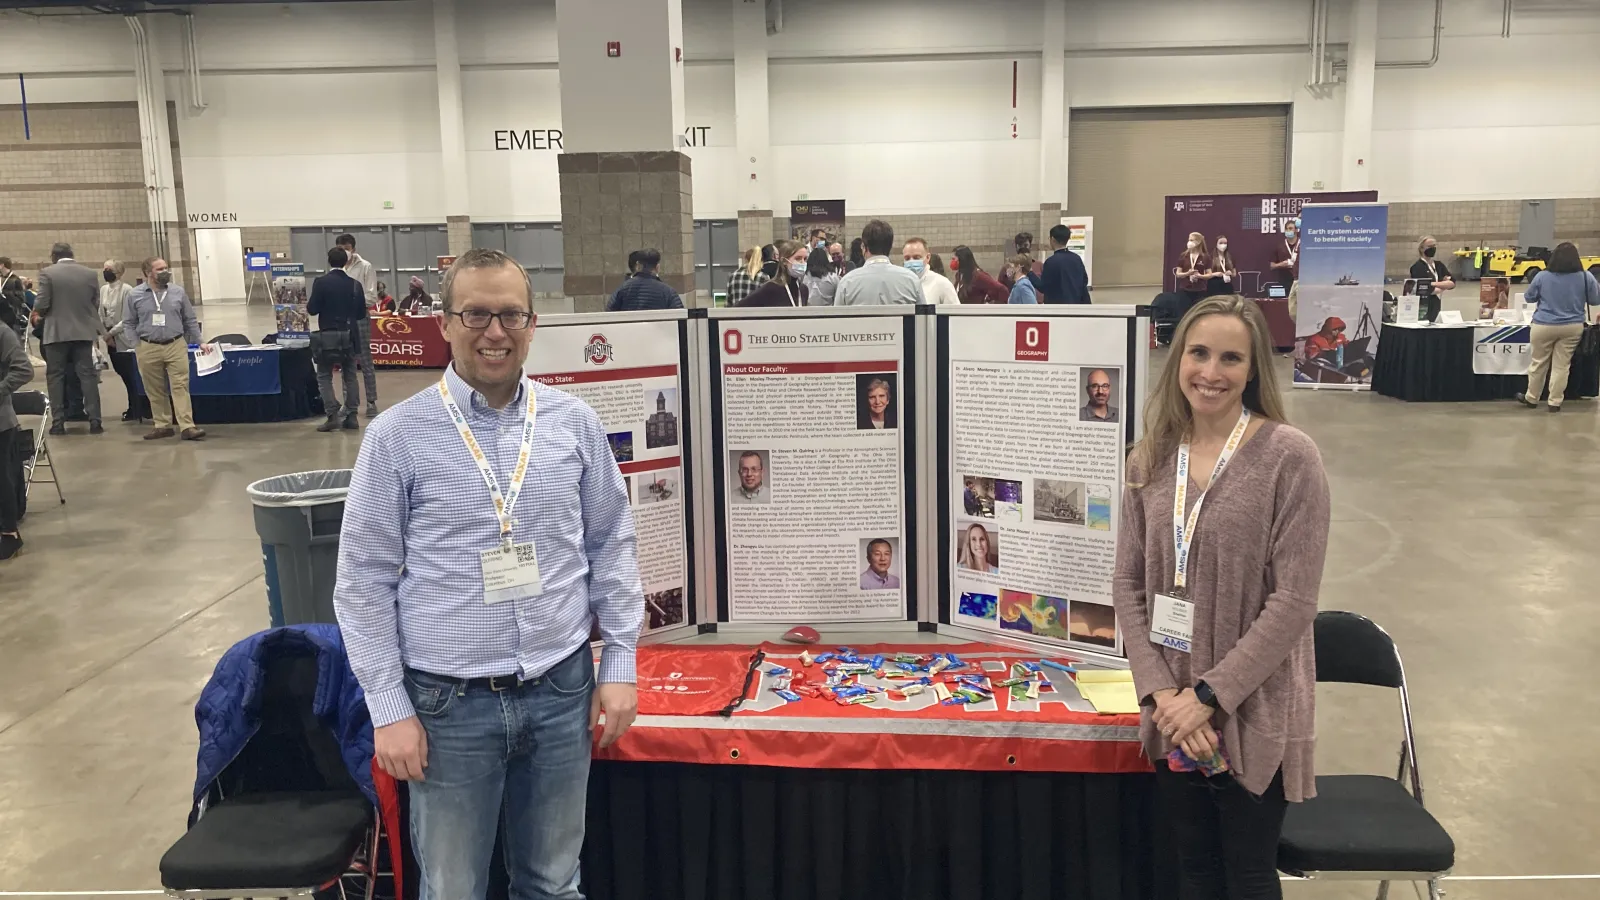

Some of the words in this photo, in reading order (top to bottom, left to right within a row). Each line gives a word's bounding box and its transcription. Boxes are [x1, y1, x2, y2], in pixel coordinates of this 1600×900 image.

[494, 129, 564, 151] EMER
[1261, 198, 1278, 215] BE
[188, 212, 238, 223] WOMEN
[1261, 217, 1277, 234] BE
[1347, 235, 1372, 243] society
[369, 343, 423, 356] SOARS
[1475, 344, 1527, 354] CIRE
[237, 356, 263, 367] people
[373, 359, 423, 367] oars.ucar.edu
[726, 365, 747, 373] About
[748, 365, 761, 373] Our
[762, 365, 788, 374] Faculty:
[537, 376, 554, 385] Ohio
[554, 375, 575, 384] State:
[448, 403, 459, 418] AMS
[1226, 422, 1245, 451] MAXAR
[462, 430, 484, 461] MAXAR
[513, 451, 529, 483] MAXAR
[483, 467, 495, 485] AMS
[503, 498, 514, 515] AMS
[1175, 484, 1185, 517] MAXAR
[1159, 626, 1181, 636] CAREER
[1162, 637, 1189, 651] AMS
